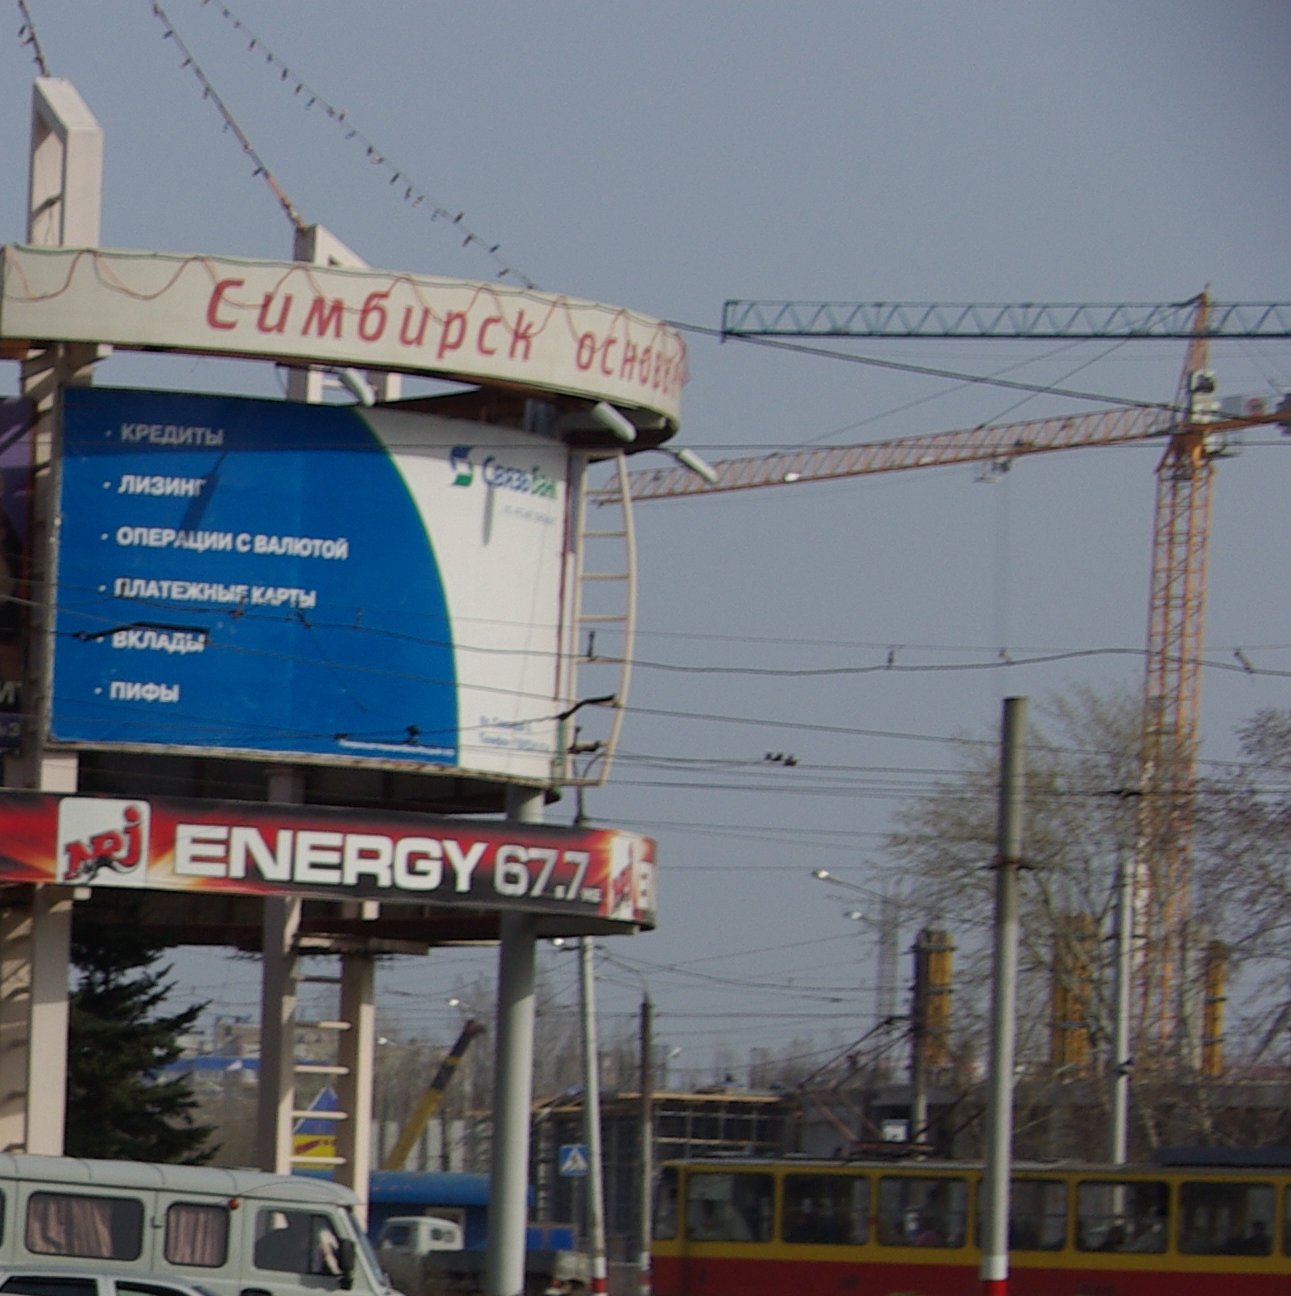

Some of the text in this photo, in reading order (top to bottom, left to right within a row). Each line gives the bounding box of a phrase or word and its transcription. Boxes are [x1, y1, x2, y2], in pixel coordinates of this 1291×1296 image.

[205, 279, 535, 361] Симбирск
[120, 423, 224, 447] КРЕДИТЫ
[117, 474, 207, 498] ЛИЗИНГ
[116, 526, 350, 559] ОПЕРАЦИИ С ВАЛЮТОЙ
[113, 577, 317, 608] ПЛАТЕЖНЫЕ КАРТЫ
[112, 629, 206, 655] ВКЛАДЫ
[109, 680, 180, 703] ПИФЫ
[174, 823, 488, 893] ENERGY
